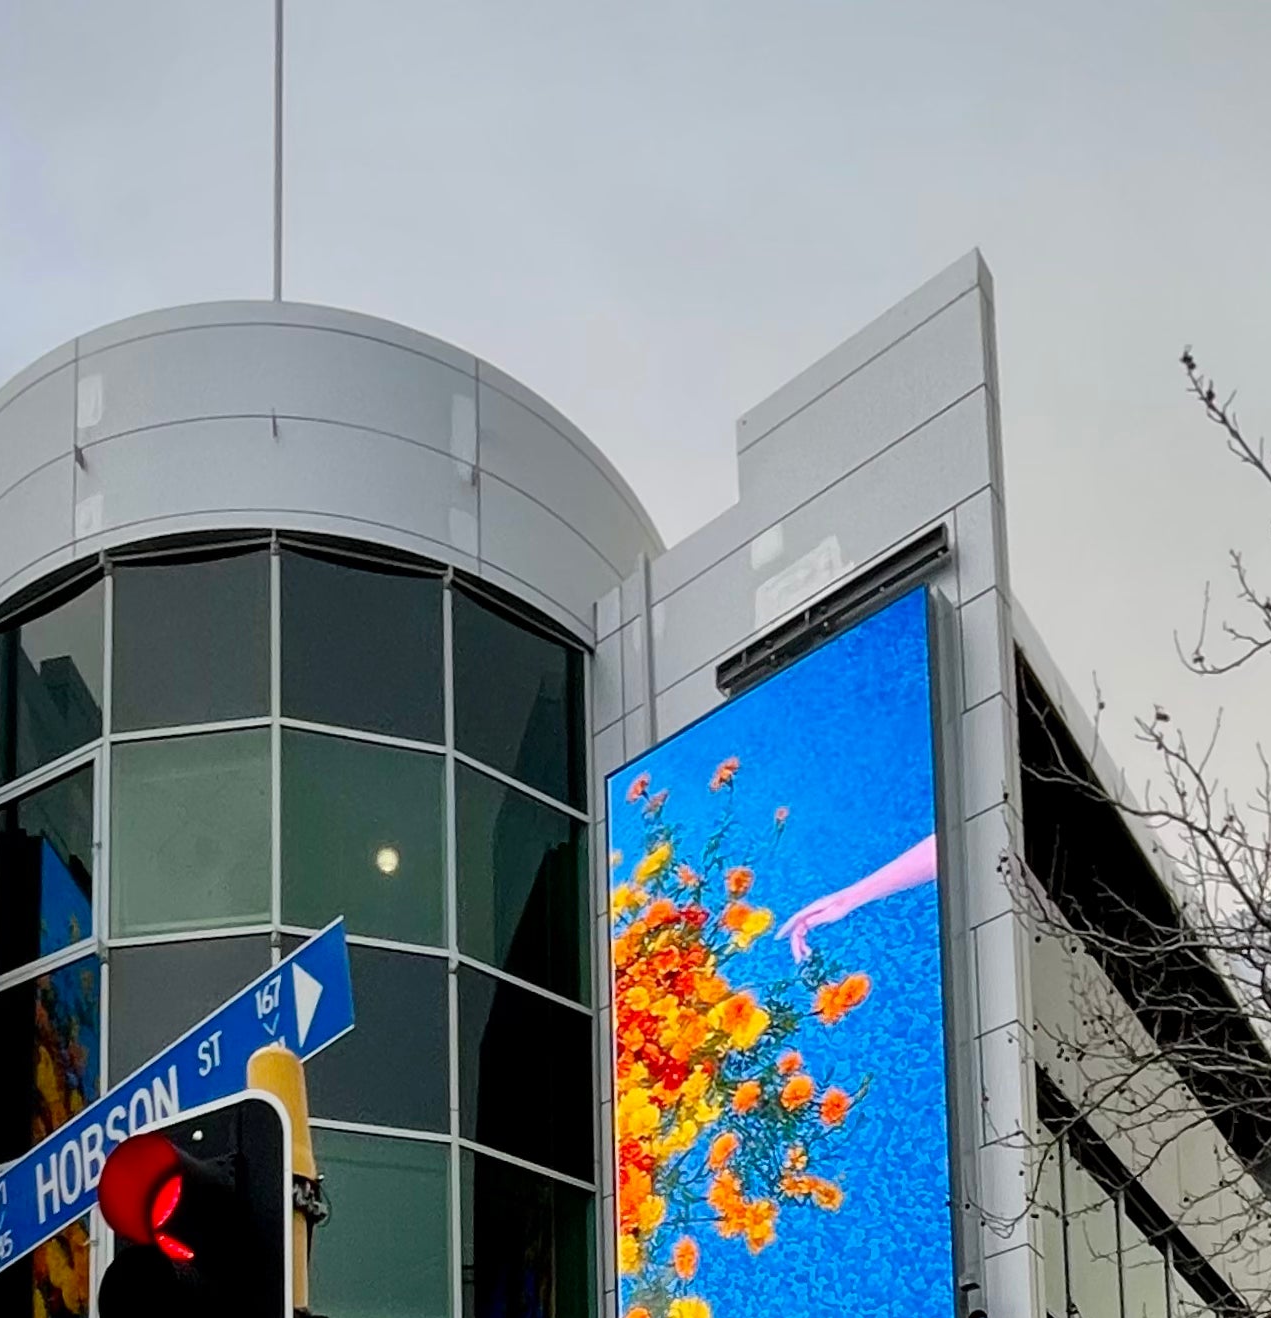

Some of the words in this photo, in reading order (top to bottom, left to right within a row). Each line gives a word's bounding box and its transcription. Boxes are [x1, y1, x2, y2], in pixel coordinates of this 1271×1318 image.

[254, 973, 282, 1019] 167
[35, 1065, 181, 1225] HOBSON
[198, 1030, 223, 1077] ST
